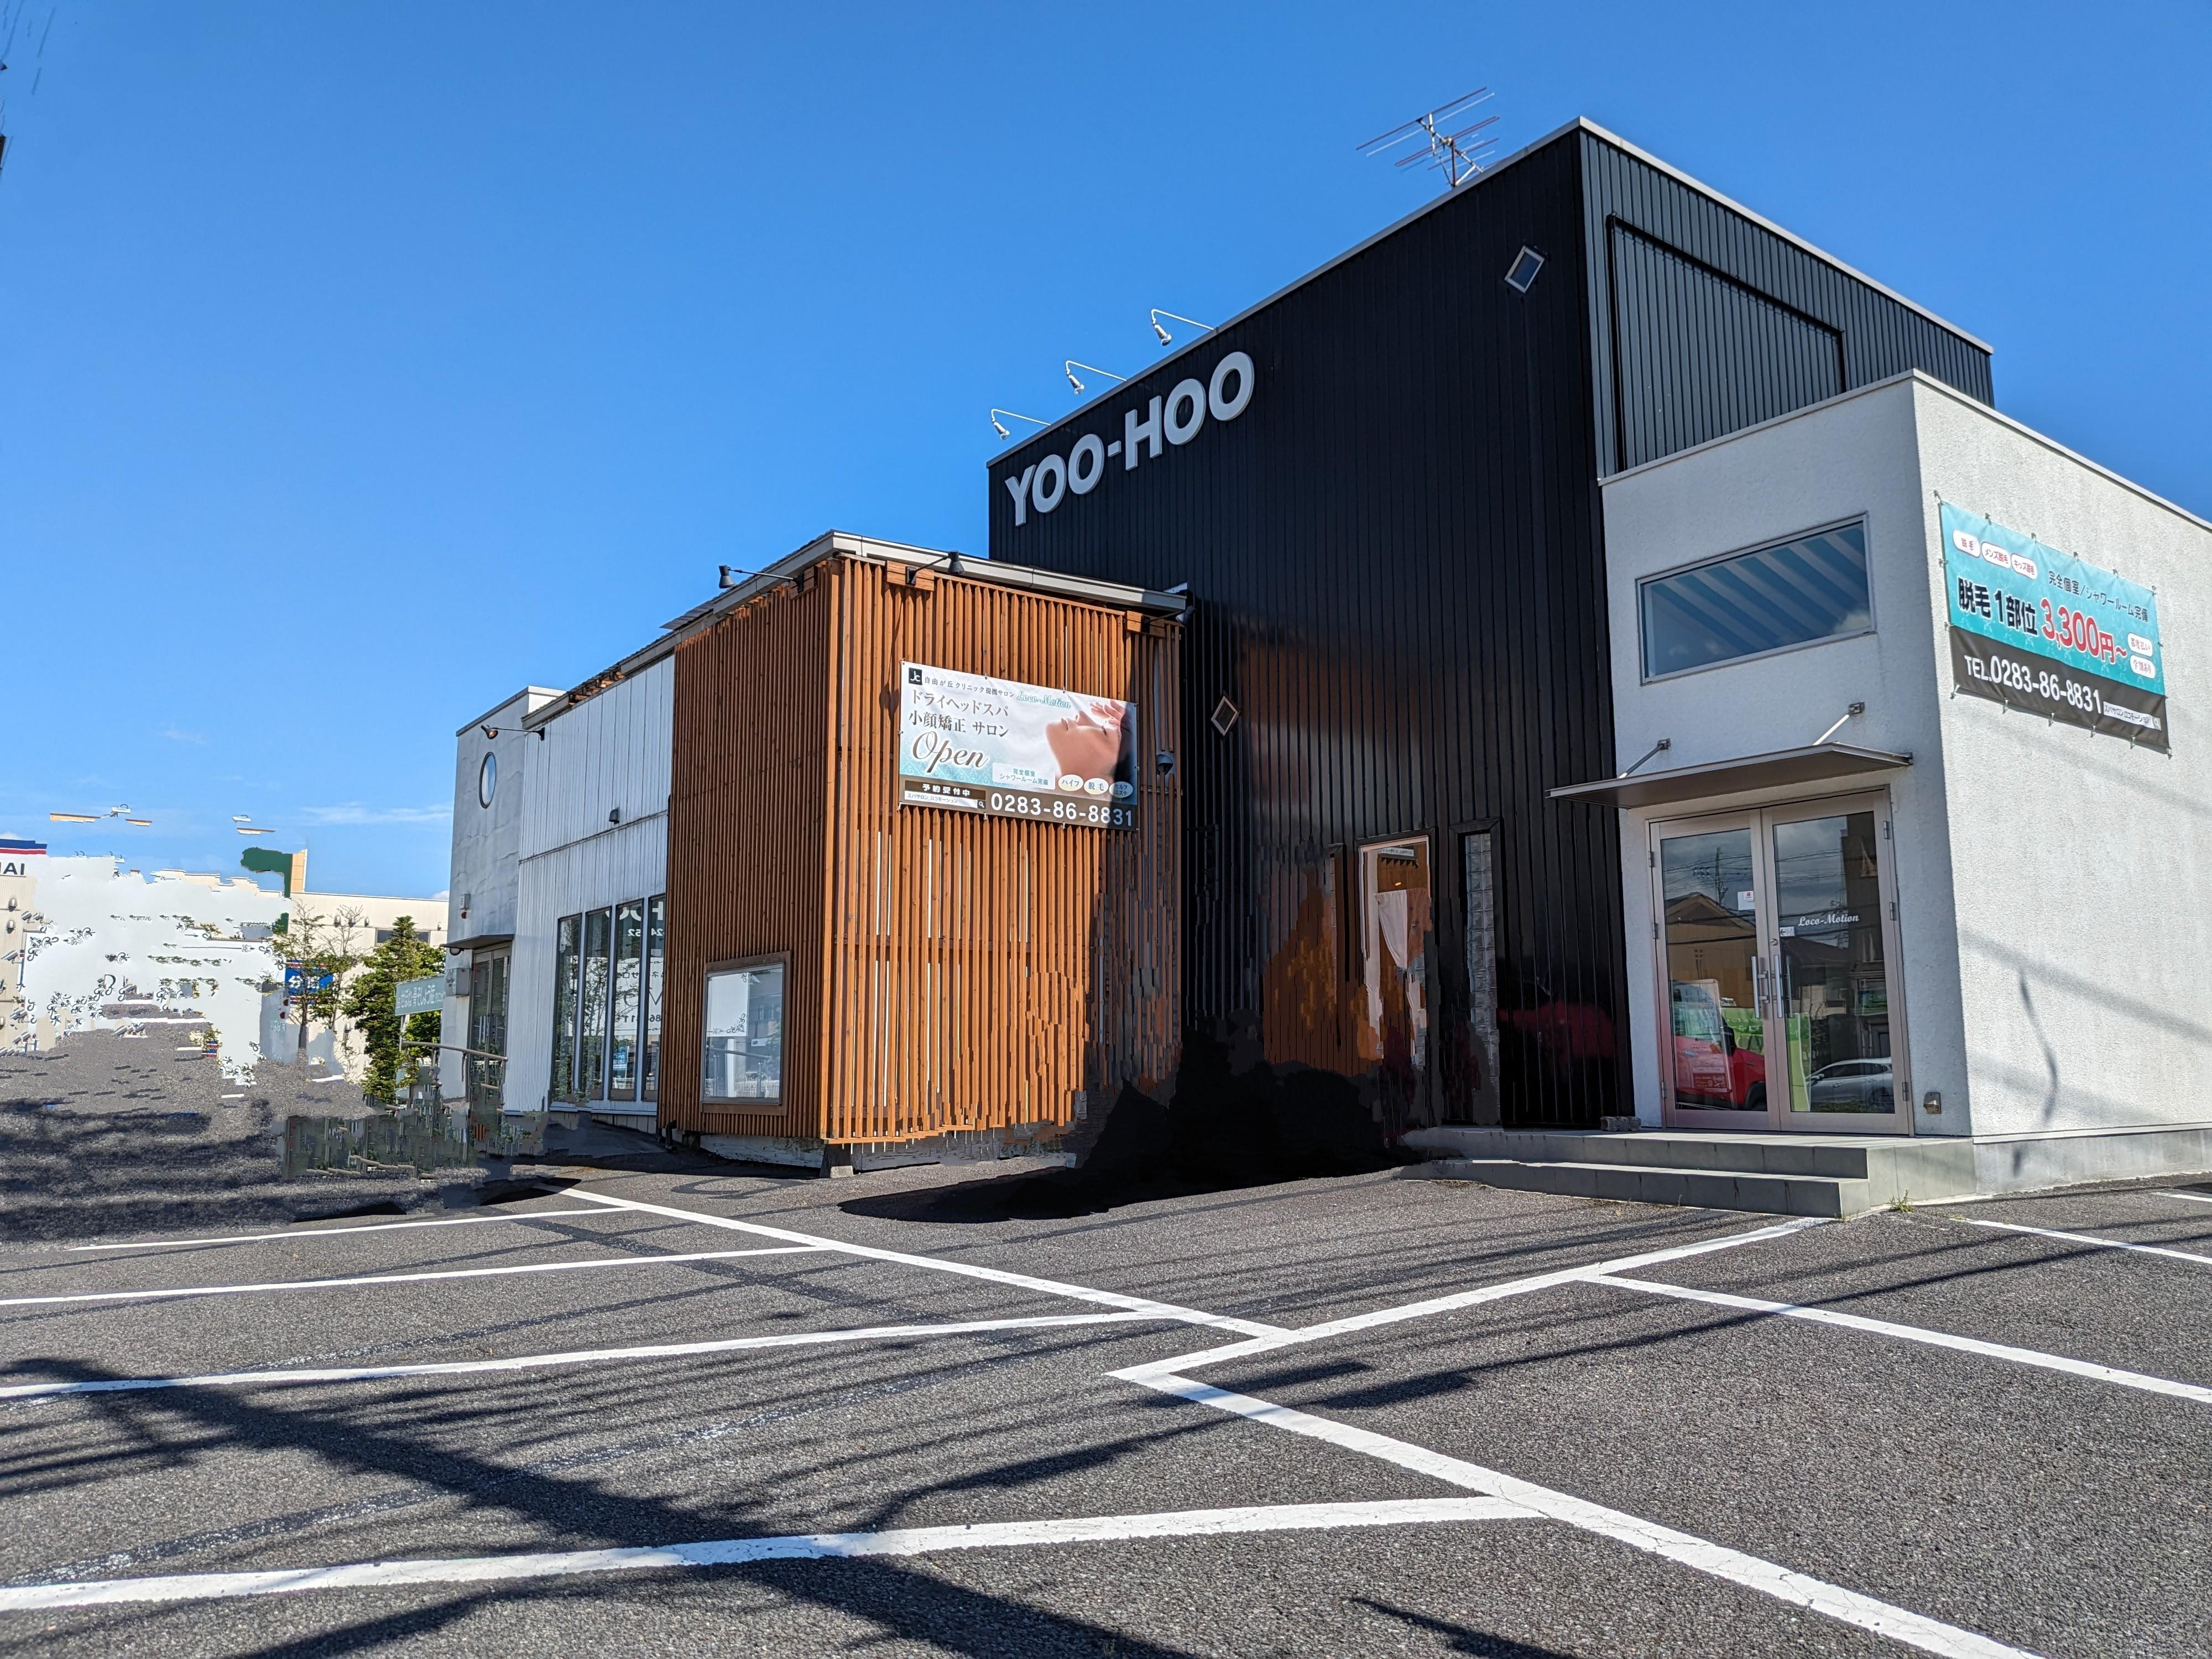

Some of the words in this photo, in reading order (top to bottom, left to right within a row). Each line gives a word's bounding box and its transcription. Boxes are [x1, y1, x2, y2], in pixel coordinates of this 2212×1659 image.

[1005, 352, 1255, 526] YOO-HOO
[1964, 655, 2101, 714] TEL.0283-86-8831
[912, 689, 1009, 717] ドライヘッドスパ
[1016, 690, 1071, 709] Loco-Motion
[909, 710, 966, 733] 小顔矯正
[972, 721, 1009, 737] サロン
[912, 731, 989, 773] Open
[1000, 773, 1048, 786] シャワールーム完備
[1013, 768, 1036, 778] 完全個室
[922, 783, 971, 797] 予約受付中
[1061, 778, 1080, 787] ハイフ
[1088, 781, 1104, 791] 脱毛
[990, 792, 1132, 827] 0283-86-8831
[0, 862, 25, 875] AI
[1798, 913, 1860, 927] Loco-Motion
